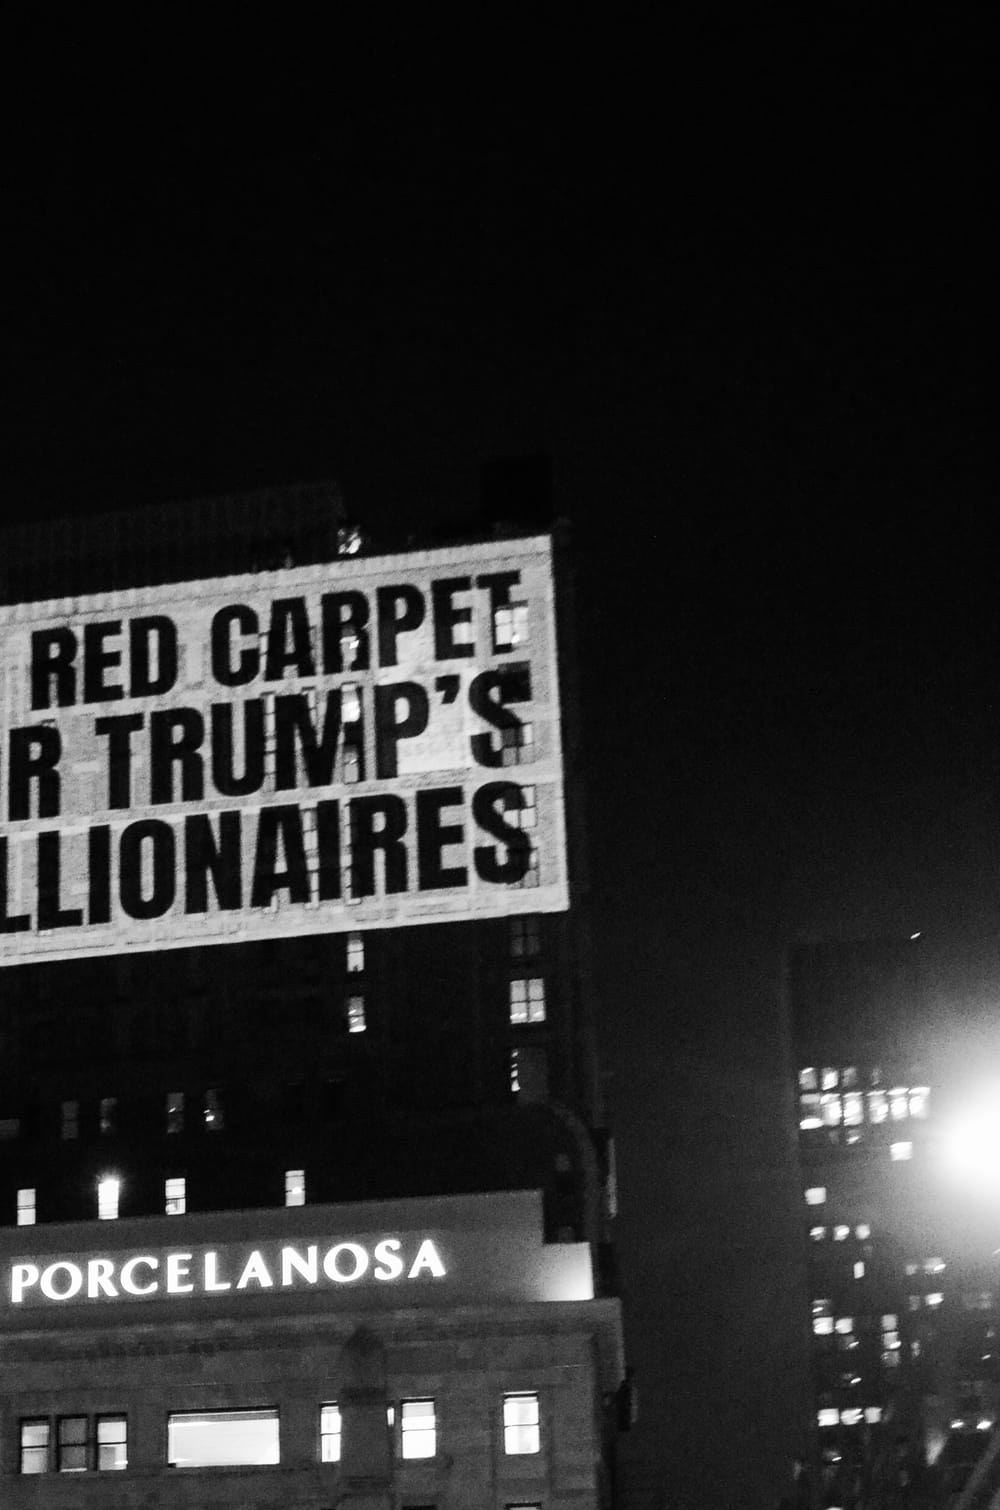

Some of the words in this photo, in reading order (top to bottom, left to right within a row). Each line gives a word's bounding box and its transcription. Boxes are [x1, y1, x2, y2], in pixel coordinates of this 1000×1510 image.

[30, 614, 178, 711] RED
[211, 570, 521, 686] CARPET
[95, 661, 533, 810] TRUMP'S
[11, 1239, 447, 1302] PORCELANOSA
